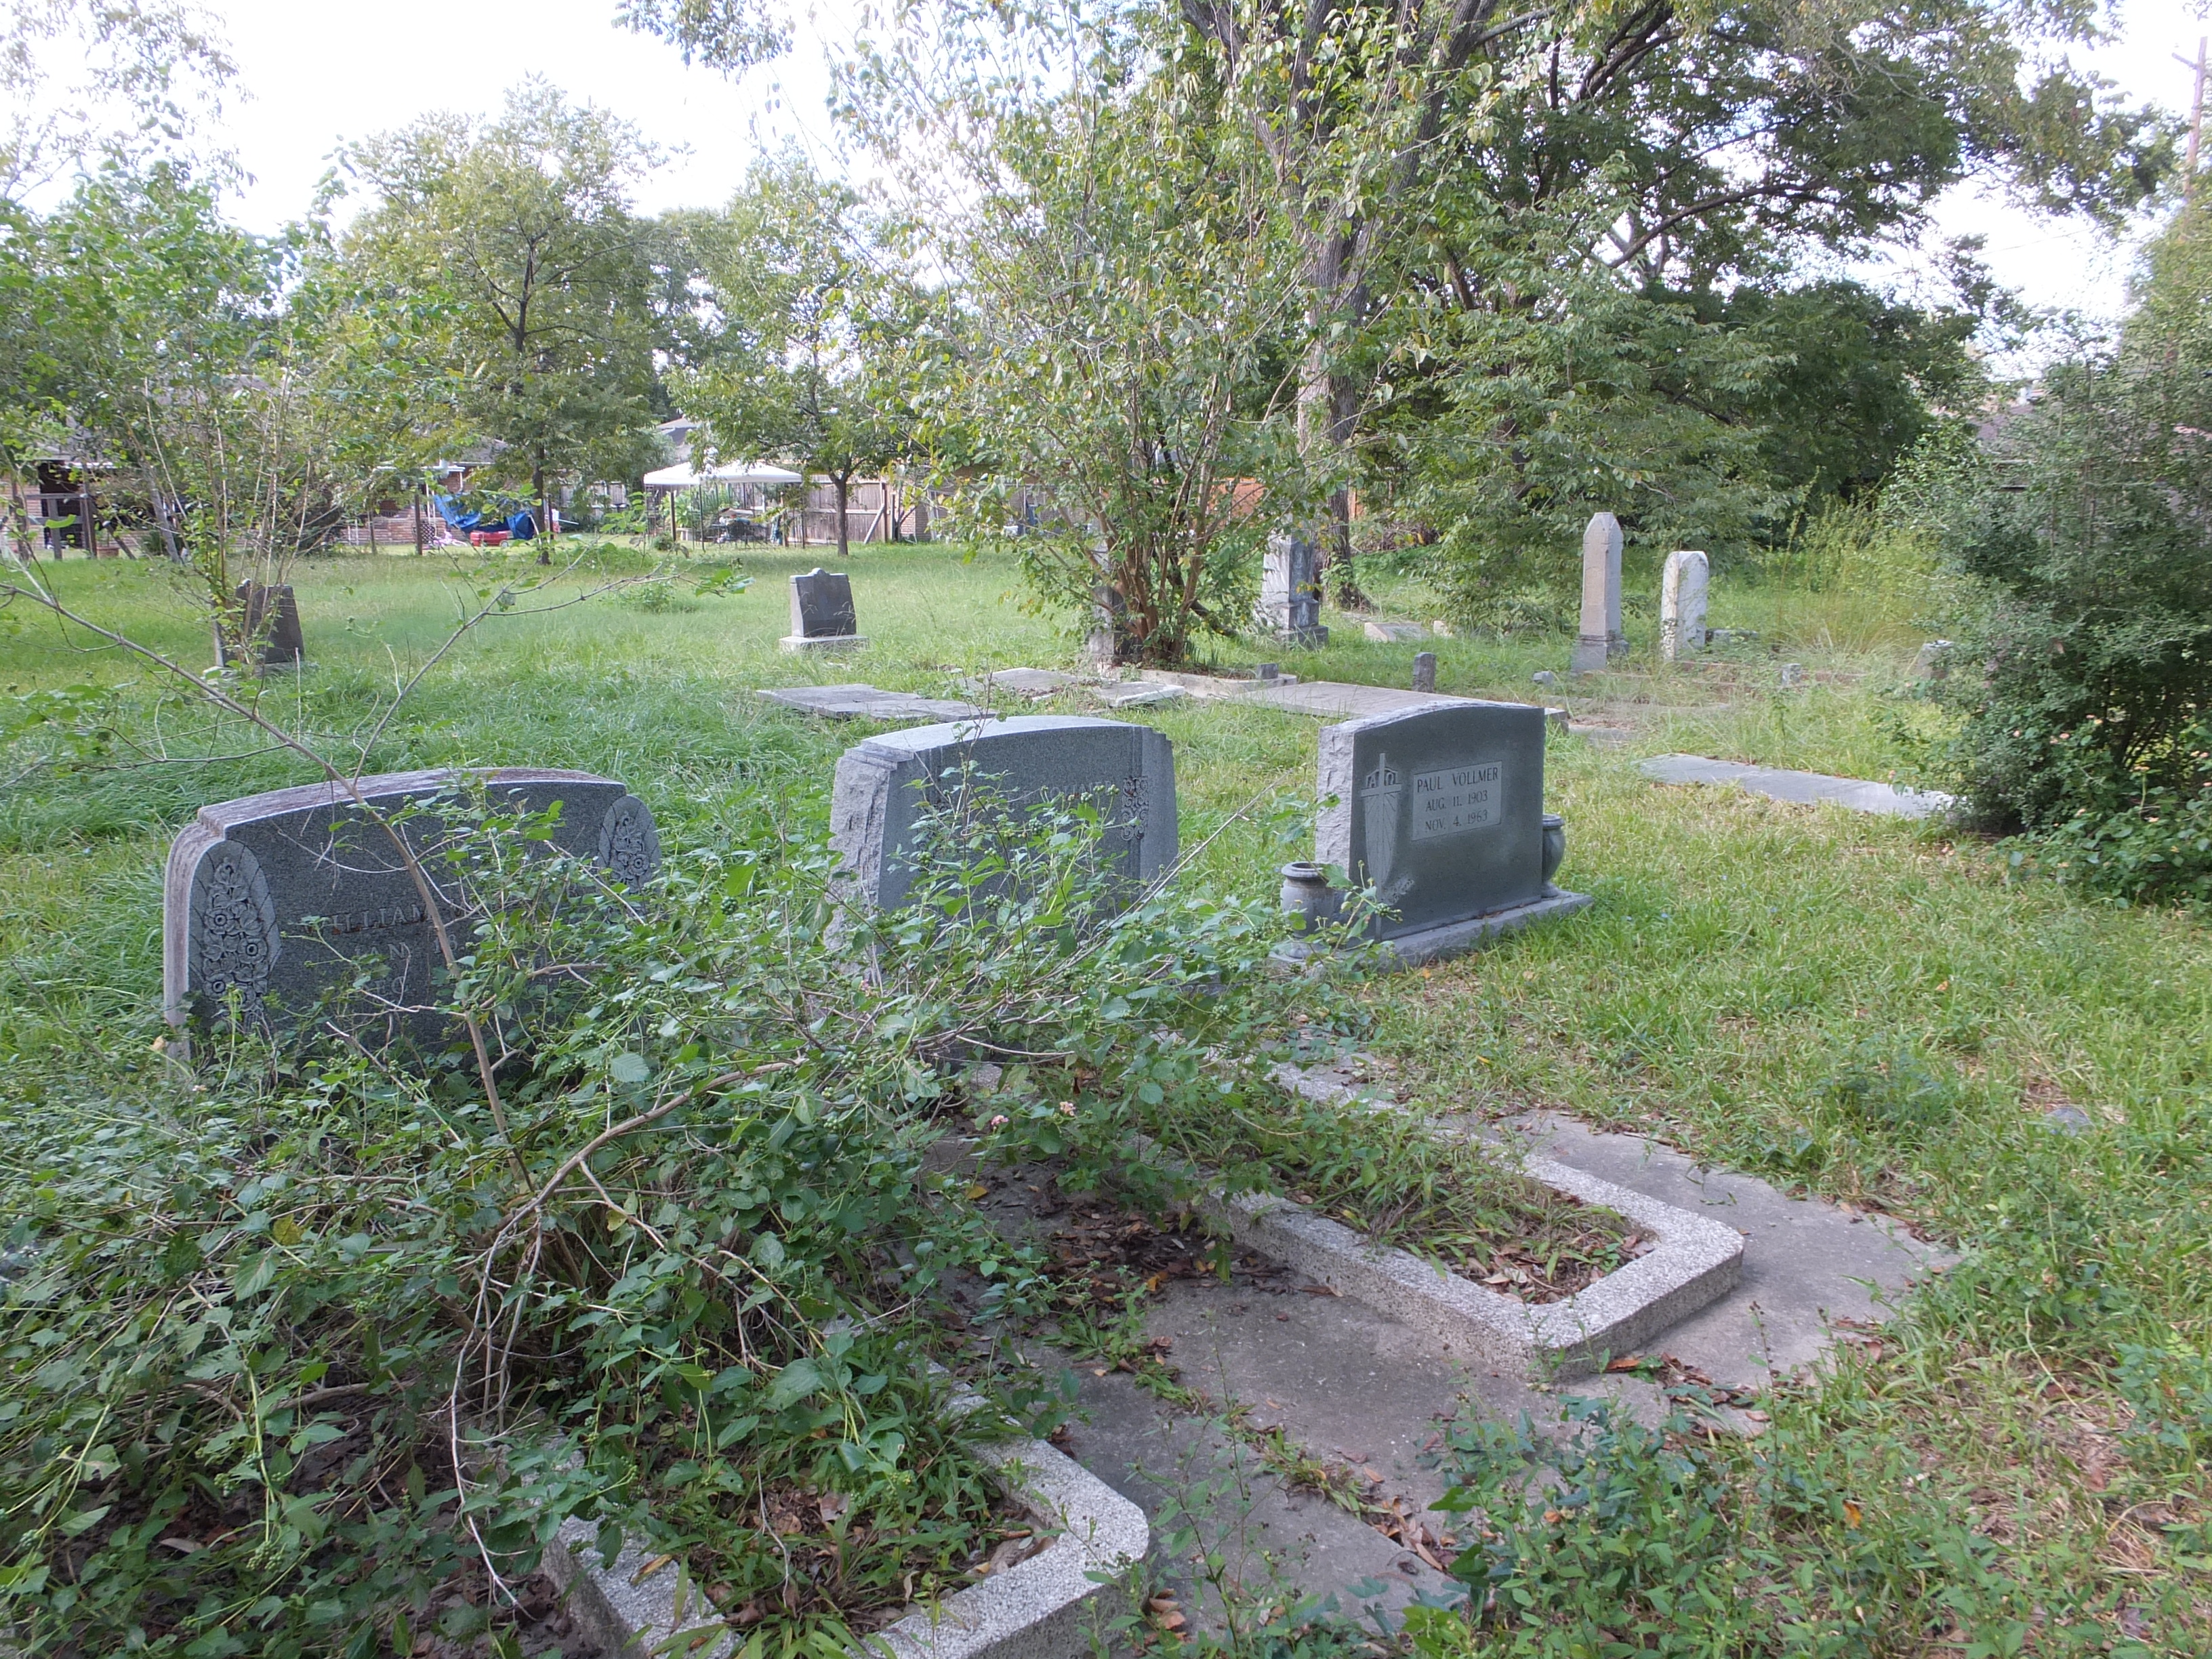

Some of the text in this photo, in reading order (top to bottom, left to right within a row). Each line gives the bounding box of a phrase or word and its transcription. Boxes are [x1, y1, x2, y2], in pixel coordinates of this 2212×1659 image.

[1417, 767, 1498, 793] PAUL VOLLMER
[1425, 797, 1447, 812] AUG.
[1468, 790, 1488, 805] 1903
[1425, 817, 1446, 832] NOV.
[1467, 809, 1488, 825] 1963
